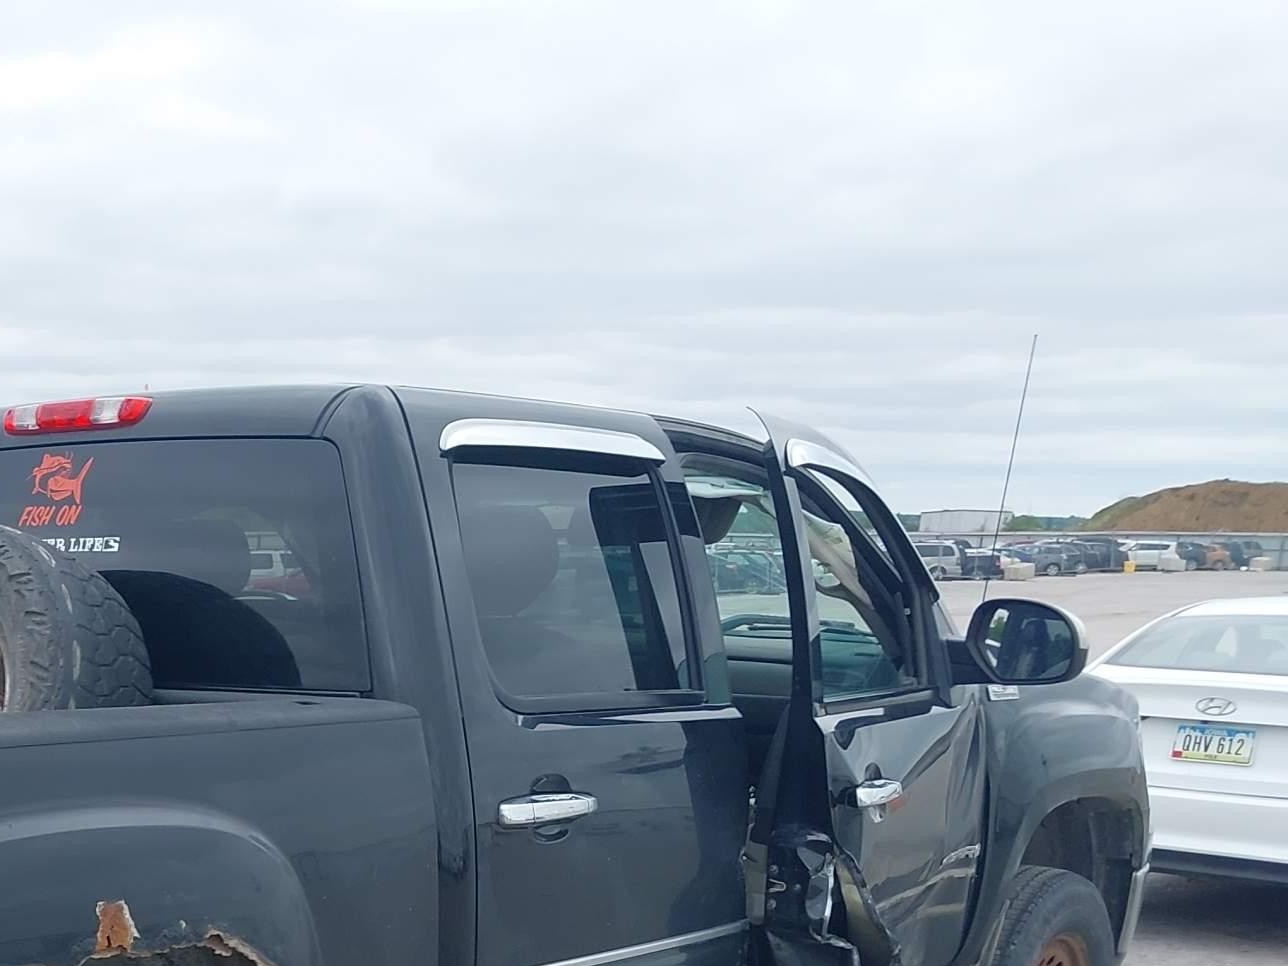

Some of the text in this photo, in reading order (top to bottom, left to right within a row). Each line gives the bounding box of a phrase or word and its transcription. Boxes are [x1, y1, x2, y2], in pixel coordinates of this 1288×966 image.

[18, 505, 82, 527] FISH ON
[1182, 734, 1245, 756] QHV 612
